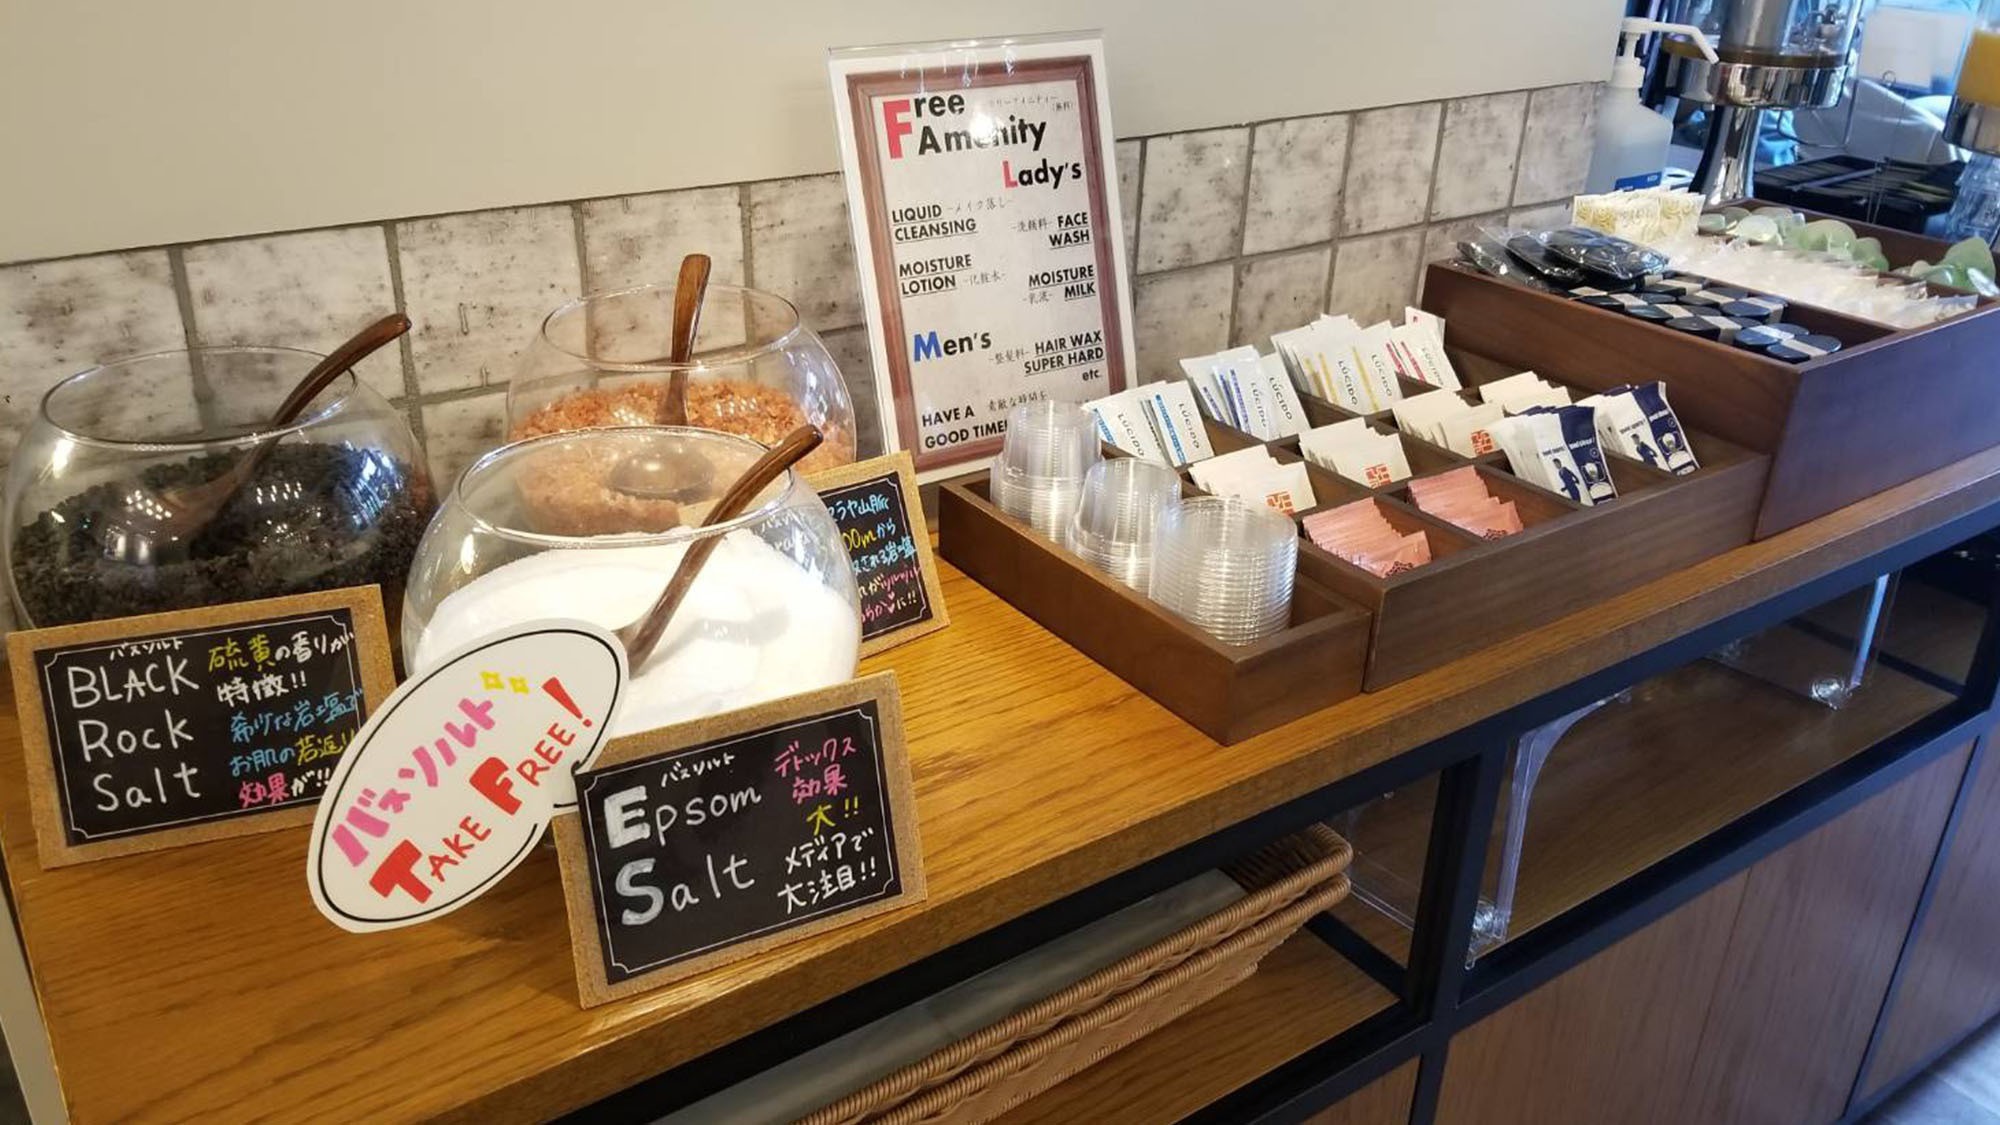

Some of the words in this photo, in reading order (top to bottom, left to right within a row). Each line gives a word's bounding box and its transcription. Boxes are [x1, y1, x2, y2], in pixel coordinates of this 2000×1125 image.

[882, 92, 965, 159] Free
[918, 113, 1047, 155] Amnity
[1002, 158, 1083, 190] Lady's
[892, 204, 943, 223] LIQUID
[1057, 212, 1089, 228] FACE
[895, 218, 977, 241] CLEANSING
[1050, 230, 1090, 247] WASH
[899, 254, 972, 277] MOISTURE
[1029, 265, 1094, 287] MOISTURE
[901, 275, 957, 295] LOTION
[1064, 282, 1096, 298] MILK
[913, 331, 992, 362] Men's
[1035, 337, 1067, 355] HAIR
[1070, 329, 1102, 348] WAX
[1024, 356, 1065, 374] SUPER
[1068, 347, 1104, 365] HARD
[922, 407, 961, 427] HAVE
[964, 405, 975, 418] A
[925, 429, 969, 449] GOOD
[67, 655, 200, 709] BLACK
[78, 709, 195, 763] Rock
[774, 737, 857, 777] デトックス
[93, 762, 201, 813] Salt
[369, 815, 492, 904] TAKE
[469, 676, 593, 816] FREE!
[792, 764, 848, 804] 効果
[604, 785, 762, 849] Epsom
[615, 855, 756, 926] Salt
